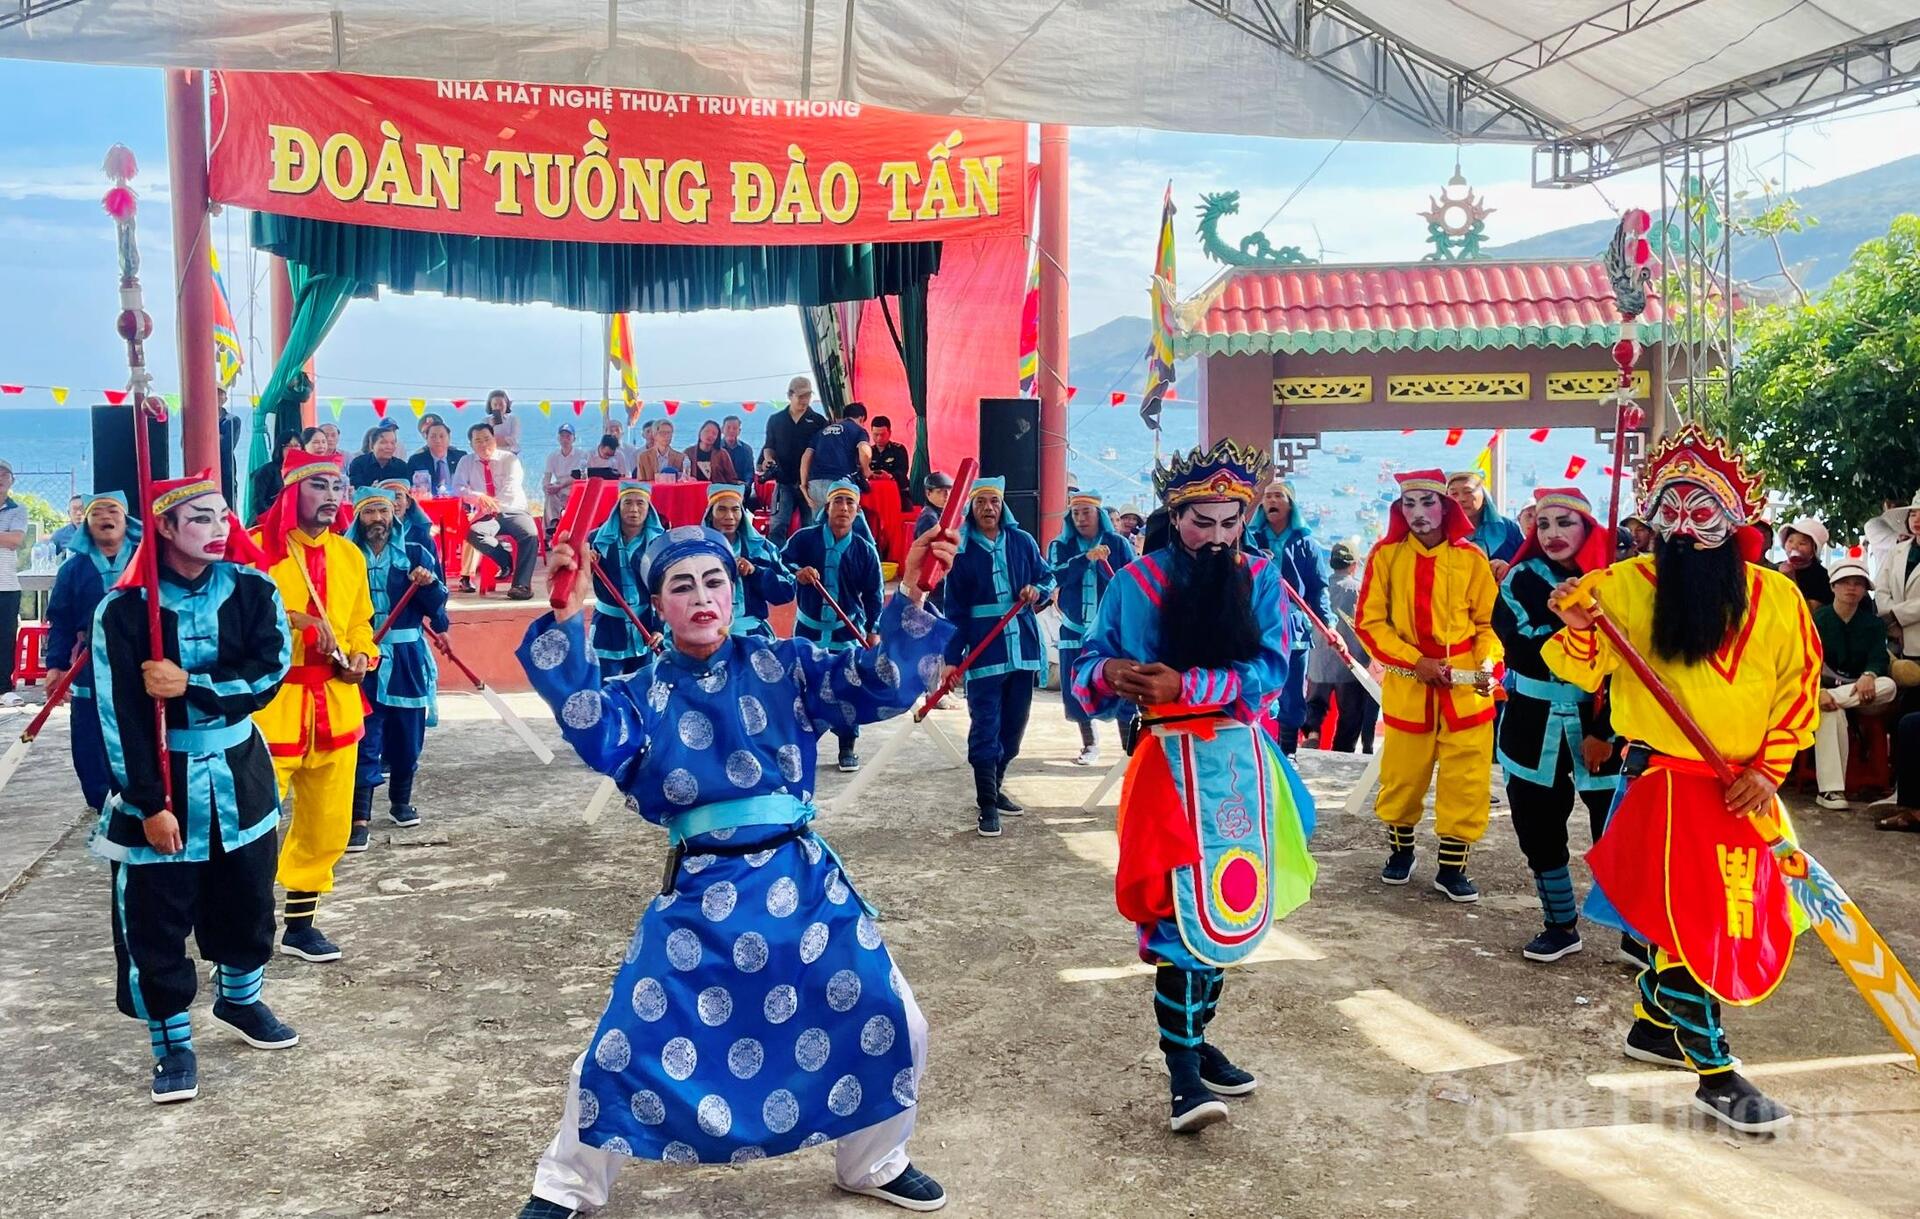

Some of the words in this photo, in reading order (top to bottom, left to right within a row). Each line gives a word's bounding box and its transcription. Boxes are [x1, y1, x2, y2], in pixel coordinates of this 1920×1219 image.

[549, 87, 613, 115] NGHỆ
[267, 119, 466, 212] ĐOÀN
[483, 118, 711, 224] TUỒNG
[729, 143, 861, 225] ĐÀO
[877, 129, 1003, 222] TẤN
